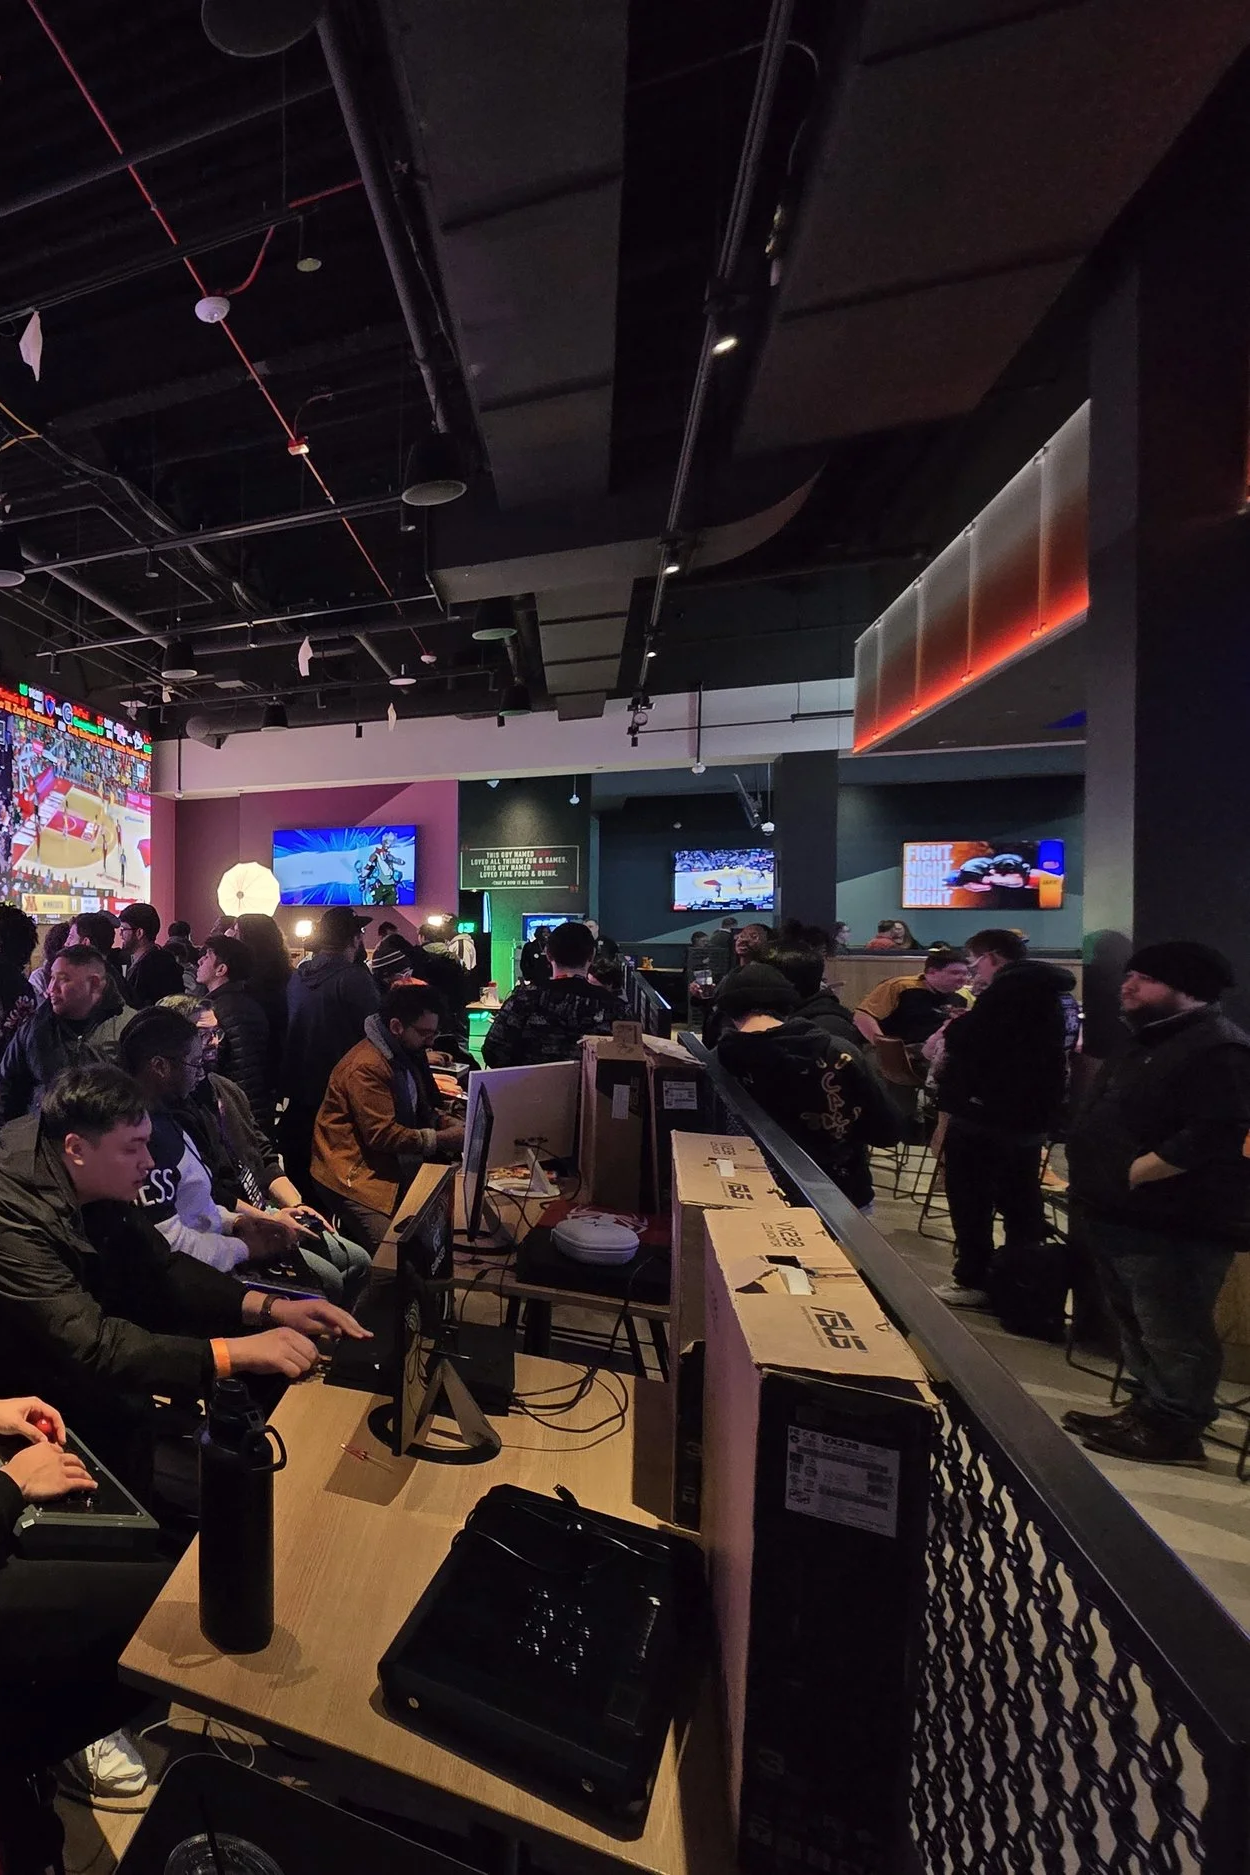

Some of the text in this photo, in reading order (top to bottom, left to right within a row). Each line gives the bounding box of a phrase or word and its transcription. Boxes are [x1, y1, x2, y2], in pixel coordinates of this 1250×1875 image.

[906, 845, 953, 860] FIGHT
[906, 860, 953, 876] NIGHT
[906, 876, 948, 890] DONE
[906, 890, 953, 905] RIGHT
[134, 1168, 175, 1207] ESS
[726, 1181, 754, 1201] ASUS
[776, 1221, 805, 1248] VX238
[810, 1305, 869, 1353] ASUS
